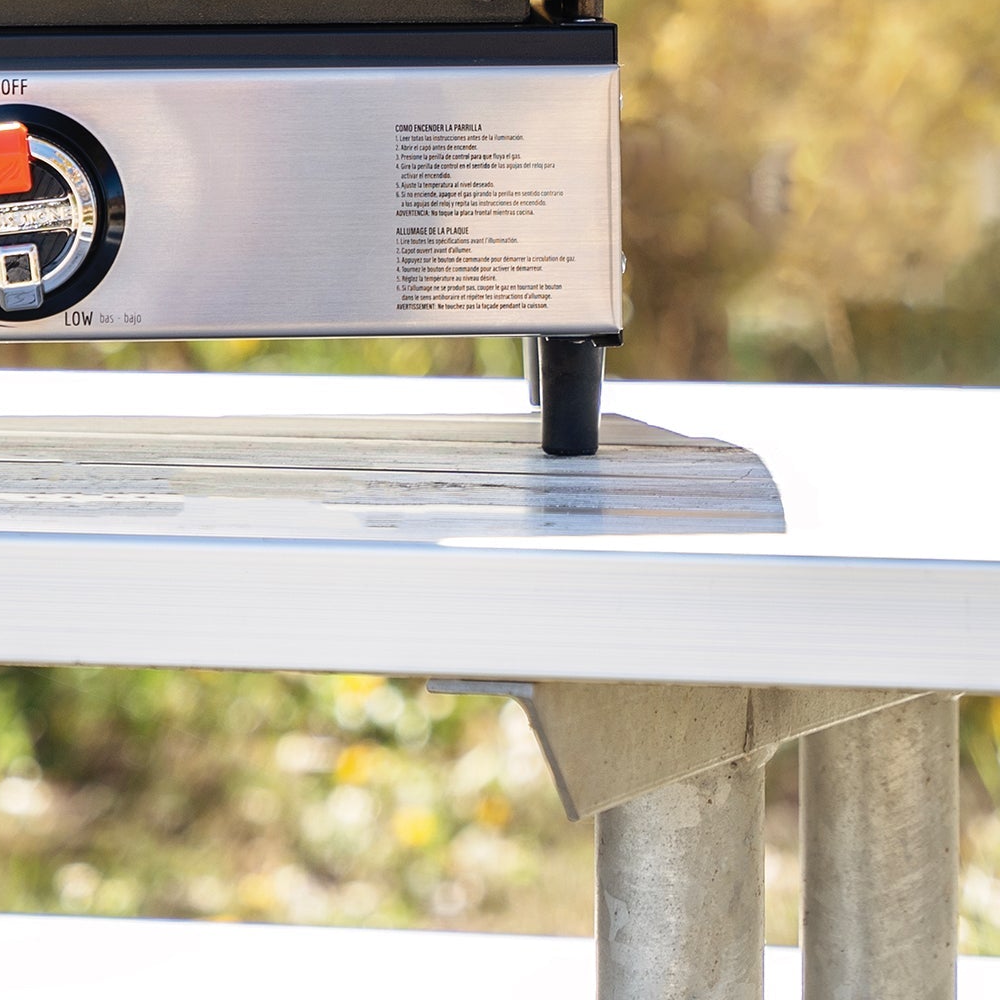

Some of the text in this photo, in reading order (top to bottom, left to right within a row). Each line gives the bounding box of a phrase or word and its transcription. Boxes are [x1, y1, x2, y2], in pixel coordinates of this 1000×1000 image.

[1, 79, 28, 96] OFF
[396, 124, 482, 133] COMO ENCENDER LA PARRILLA
[396, 227, 469, 236] ALLUMAGE DE LA PLAQUE
[65, 311, 93, 327] LOW
[99, 312, 115, 324] bas
[123, 312, 142, 326] bajo
